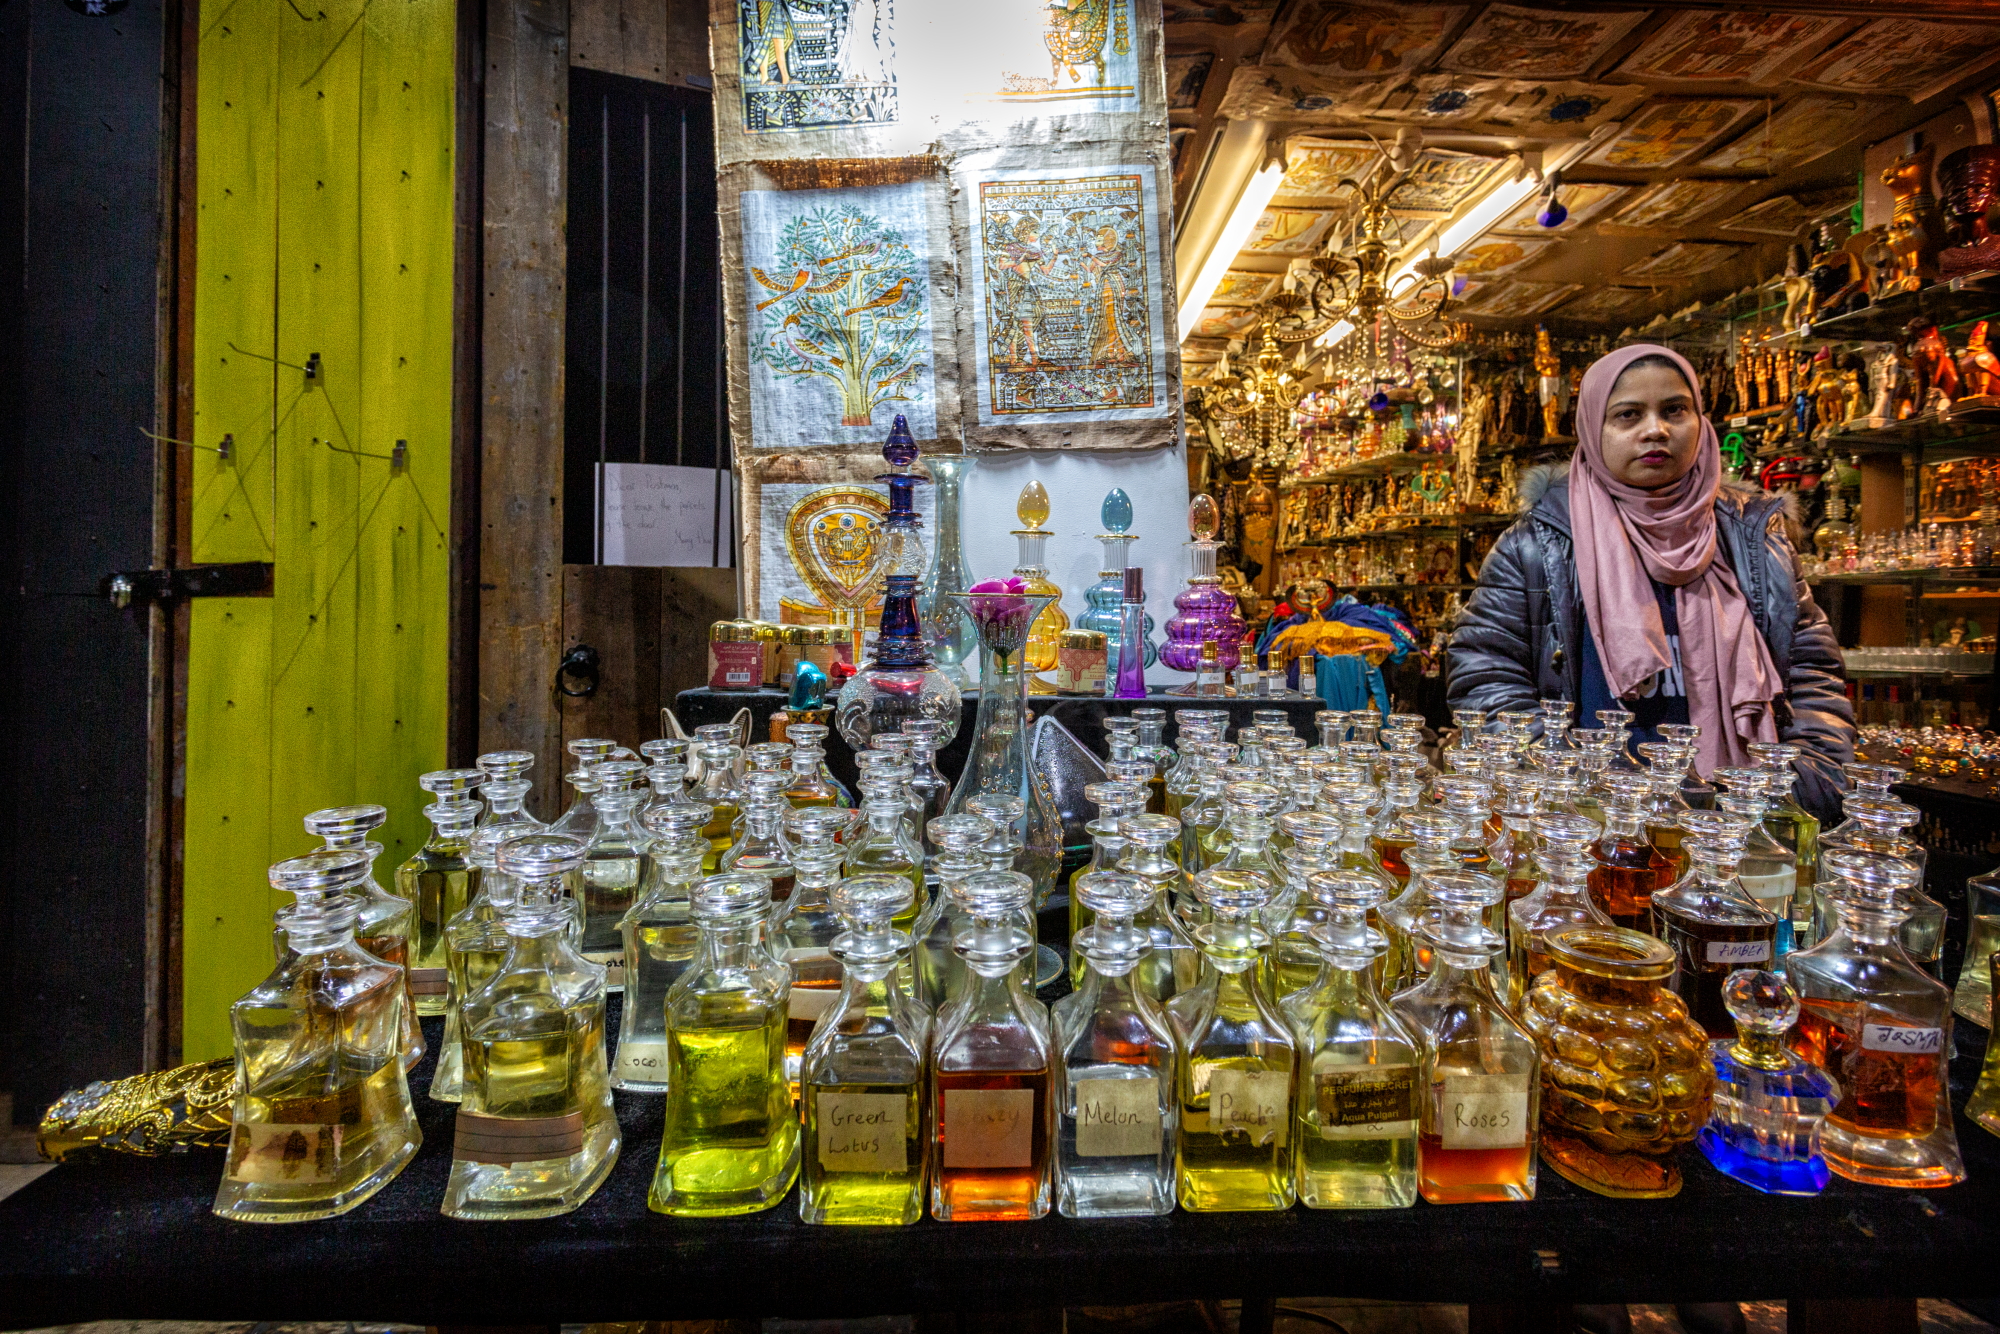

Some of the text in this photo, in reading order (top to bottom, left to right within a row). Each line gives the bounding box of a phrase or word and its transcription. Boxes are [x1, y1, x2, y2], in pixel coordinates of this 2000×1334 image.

[1322, 1080, 1414, 1096] PERFUME SECRET
[831, 1105, 894, 1126] Green
[1085, 1101, 1142, 1127] Melon
[1219, 1092, 1268, 1126] Peach
[1342, 1113, 1365, 1123] Aqua
[1454, 1102, 1510, 1128] Roses
[829, 1136, 879, 1154] Lotus
